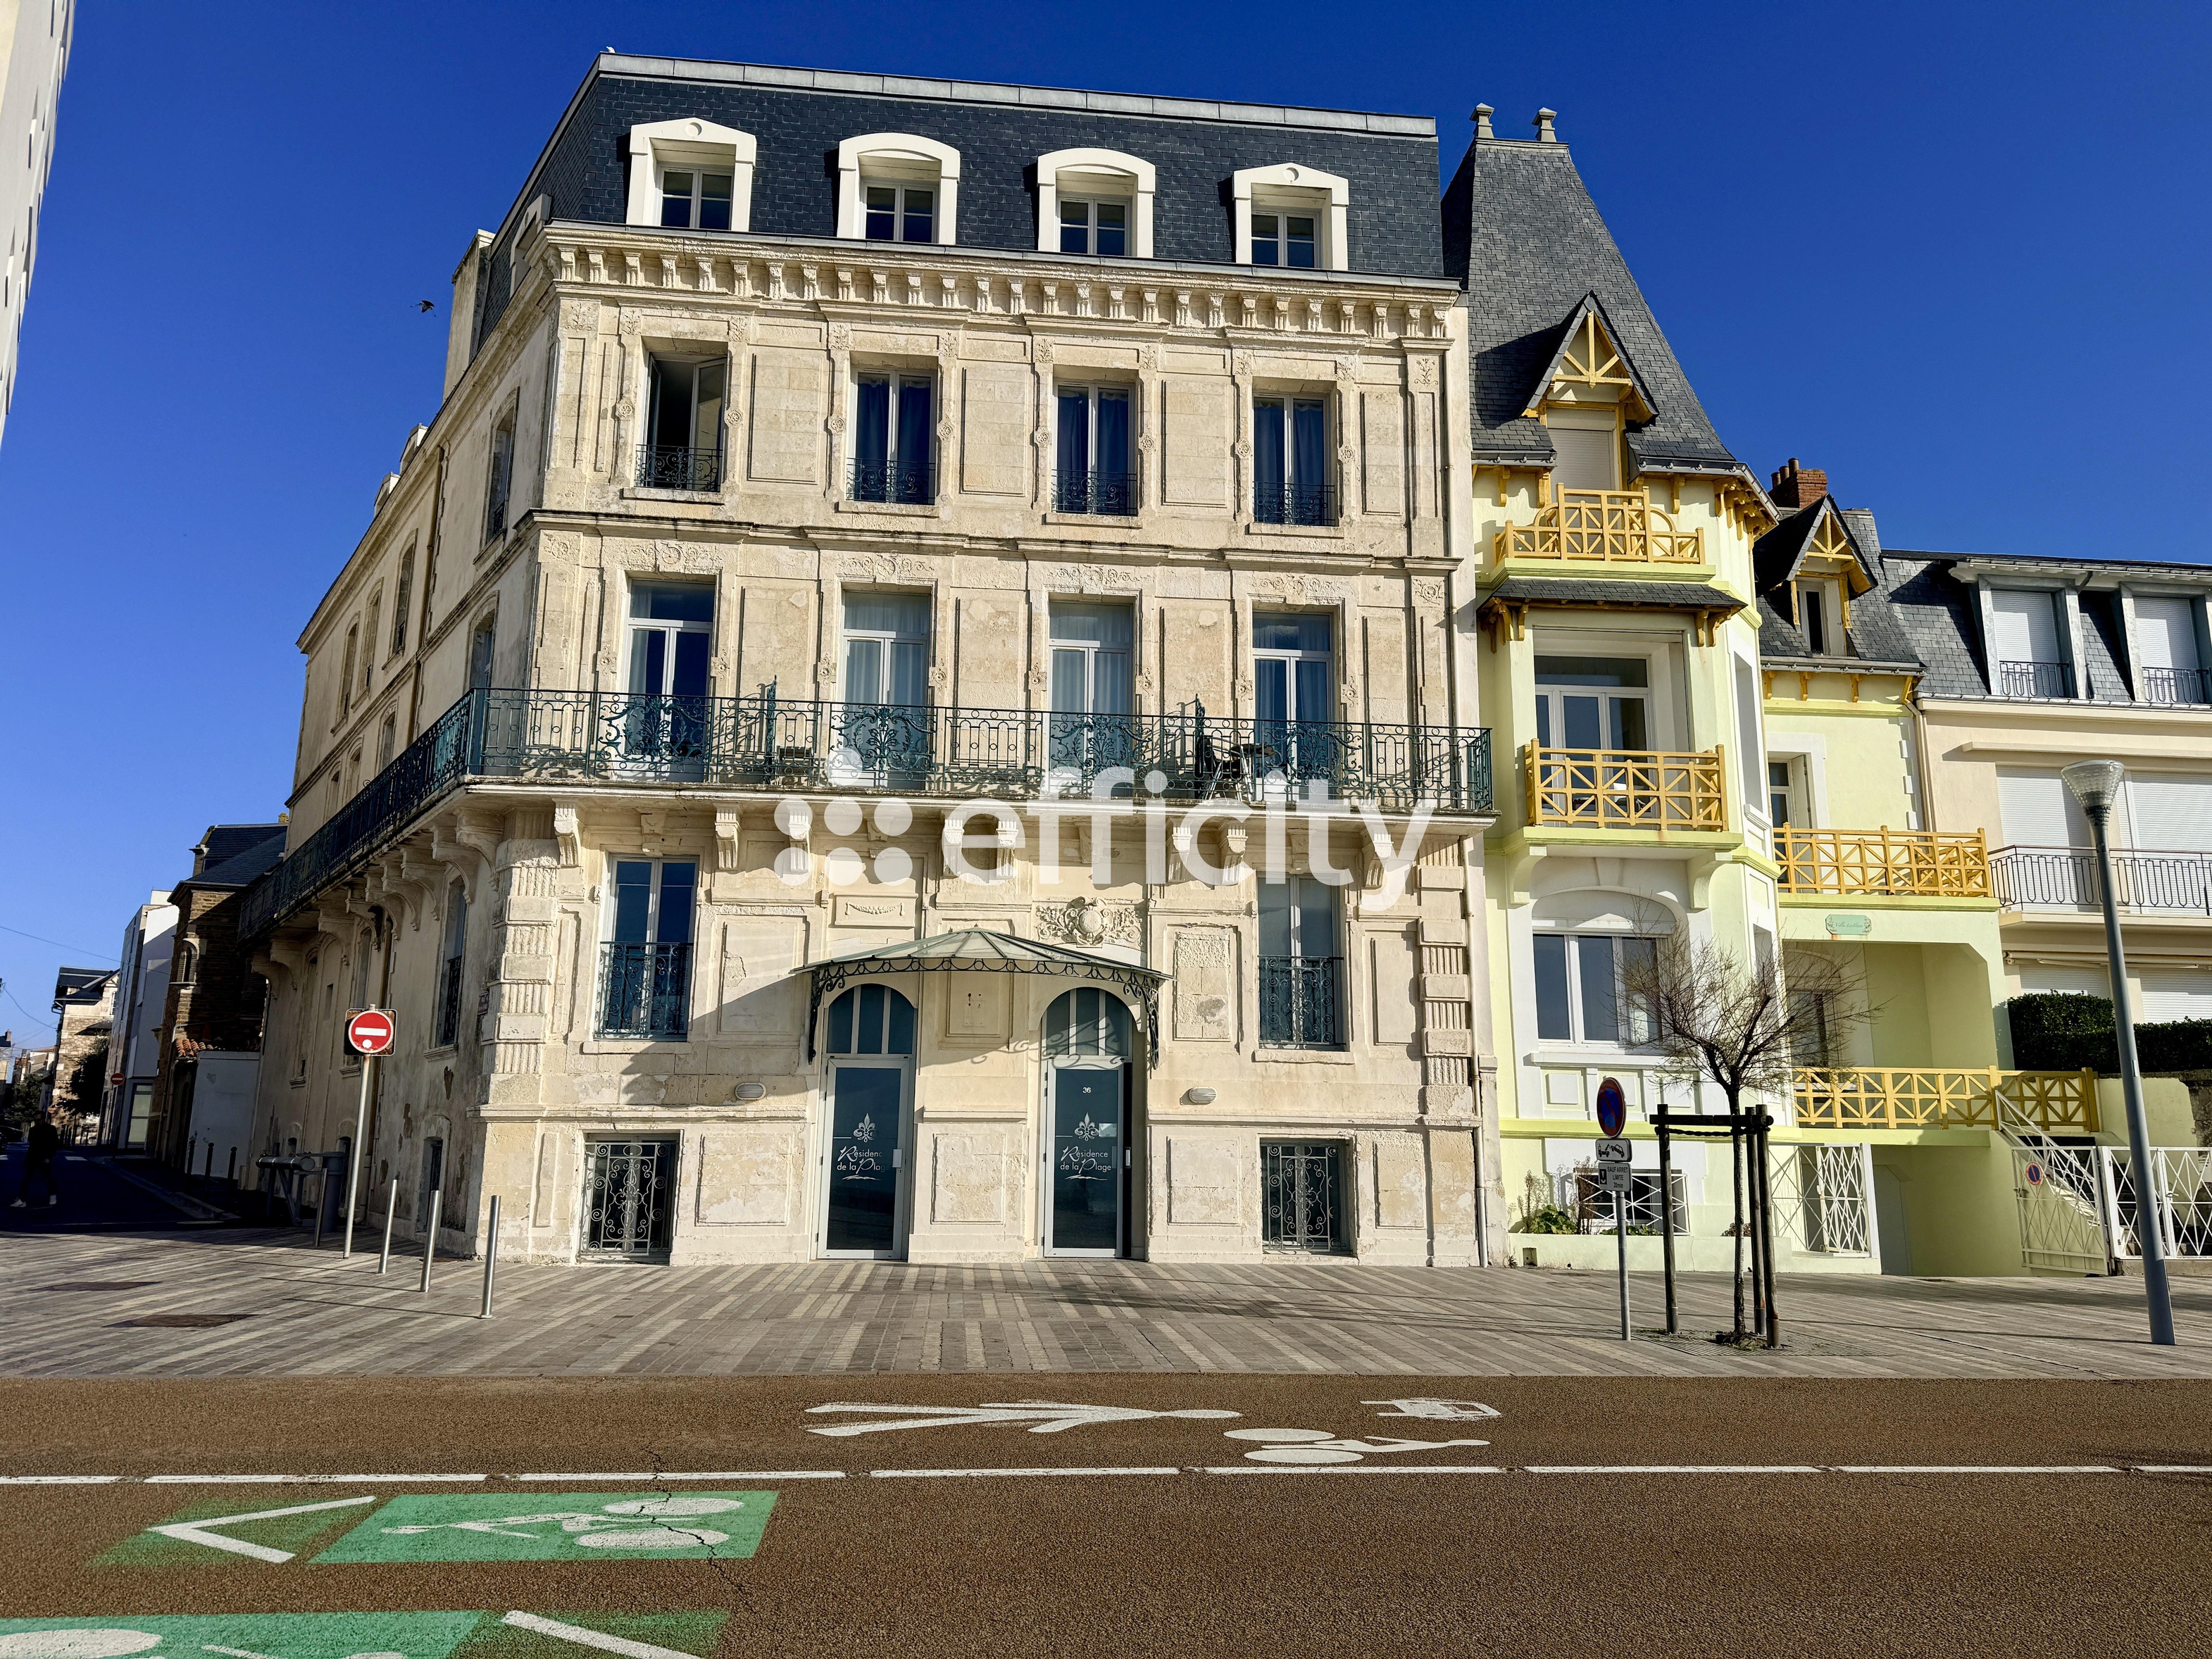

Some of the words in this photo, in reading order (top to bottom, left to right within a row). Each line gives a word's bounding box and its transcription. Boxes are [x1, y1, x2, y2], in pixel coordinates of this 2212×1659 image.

[837, 1145, 883, 1163] Résidenc
[1061, 1145, 1108, 1162] Résidence
[837, 1161, 847, 1170] de
[849, 1161, 856, 1170] la
[856, 1158, 888, 1175] Plag
[1060, 1161, 1070, 1170] de
[1072, 1161, 1079, 1170] la
[1078, 1158, 1112, 1174] Plage
